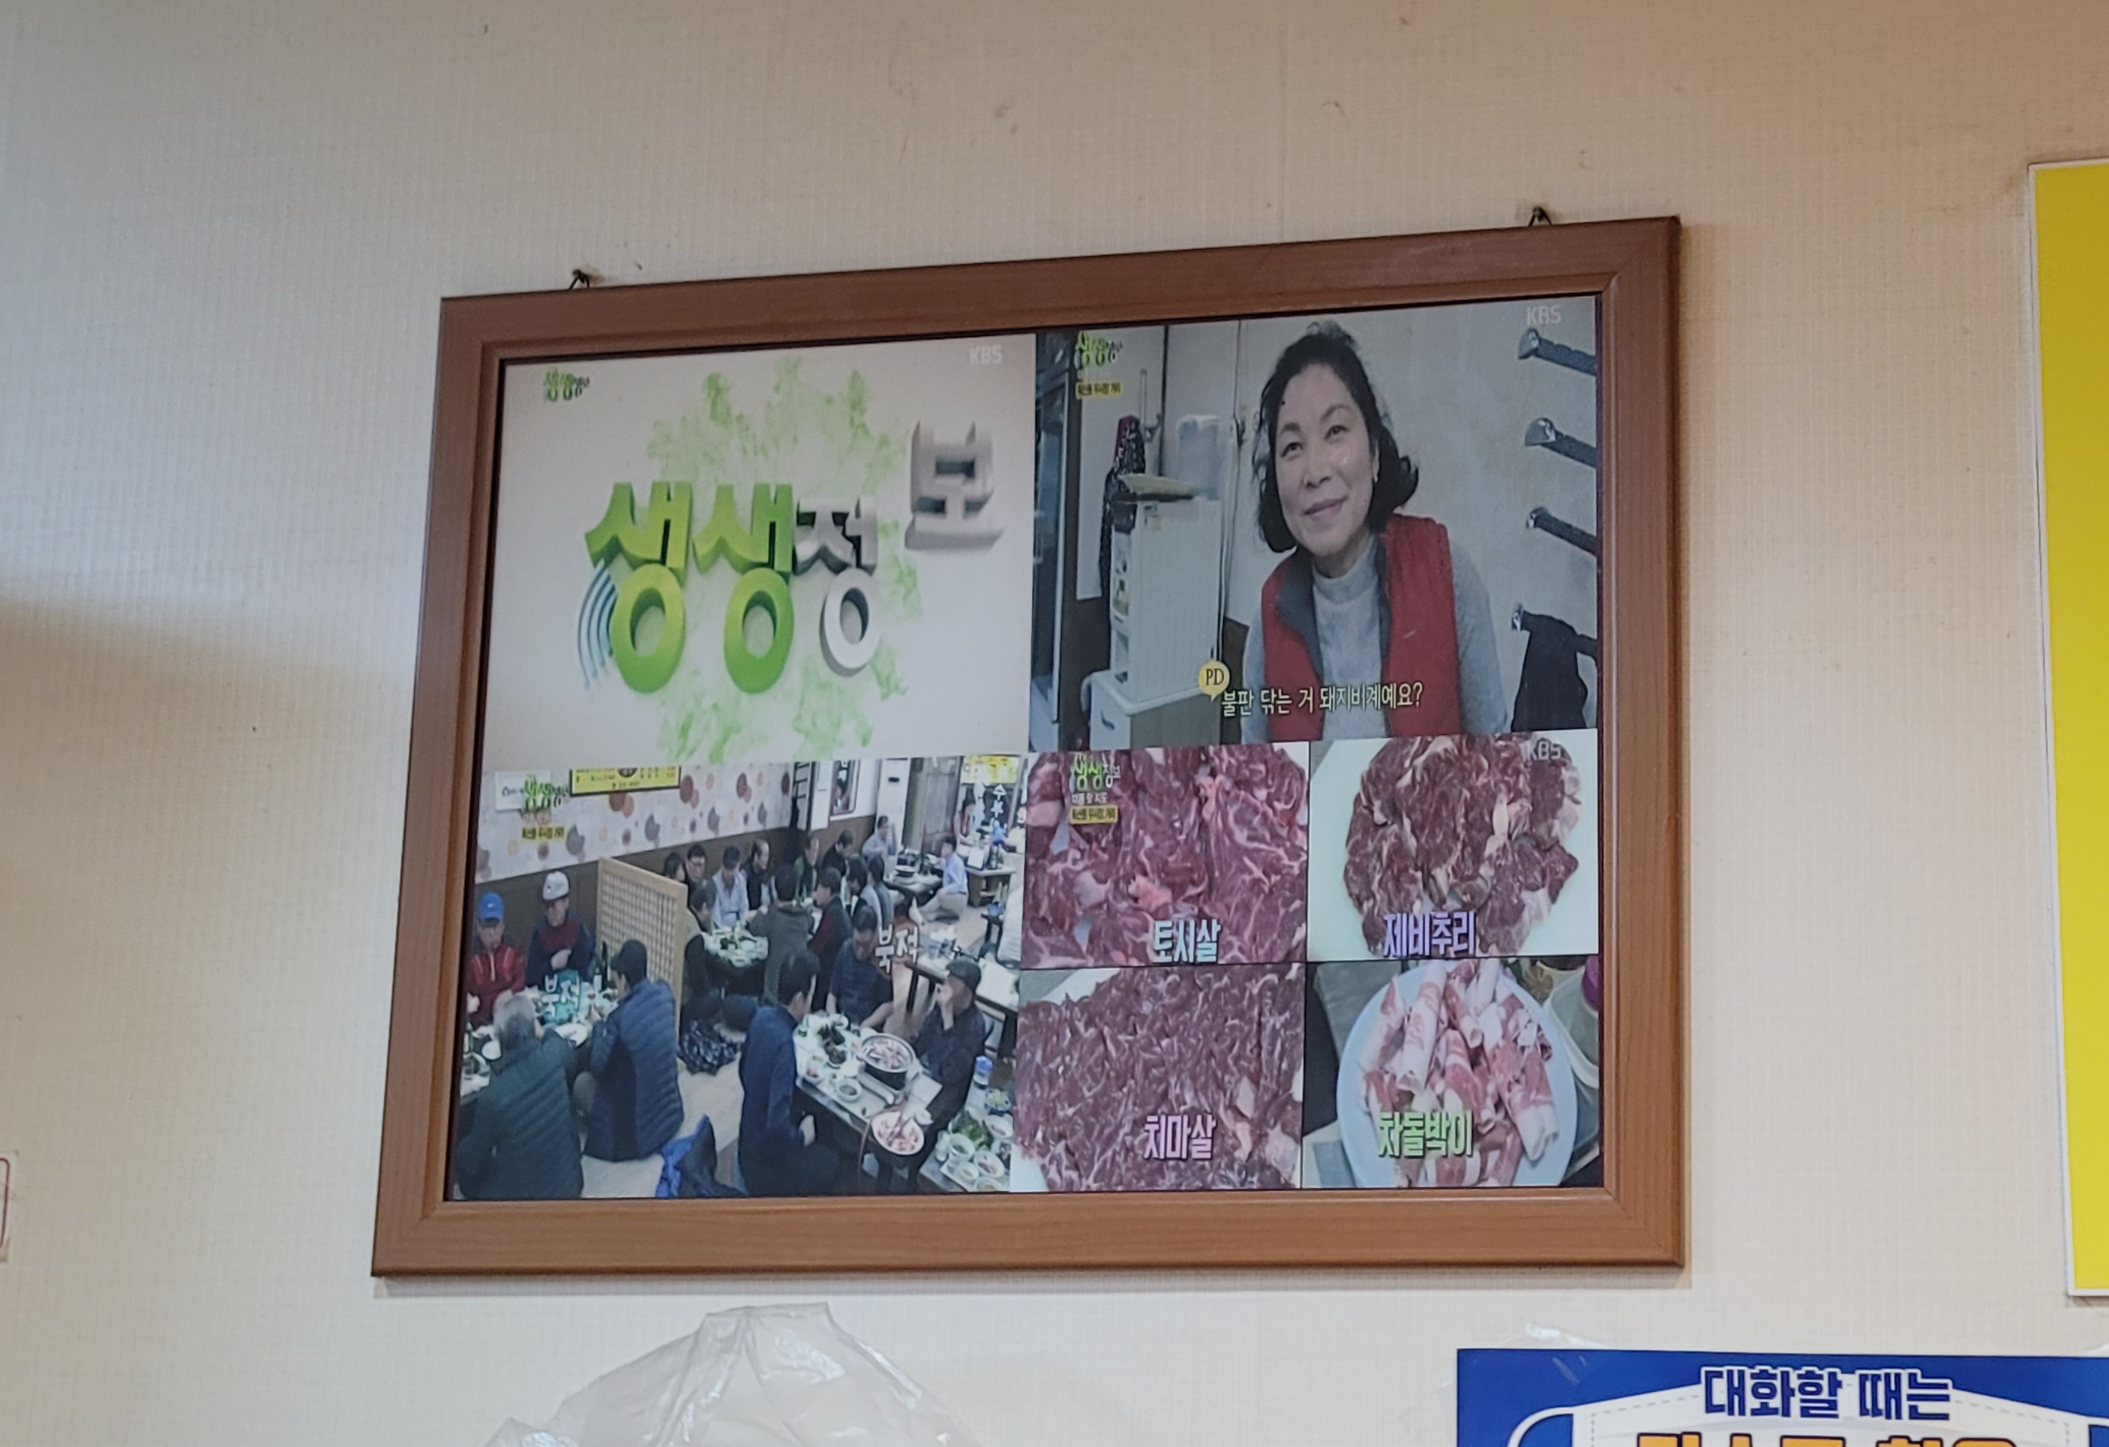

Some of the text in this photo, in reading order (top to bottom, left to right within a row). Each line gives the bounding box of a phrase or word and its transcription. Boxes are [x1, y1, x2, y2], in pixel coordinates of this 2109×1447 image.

[1526, 305, 1562, 327] KBS
[968, 345, 1004, 365] KBS
[584, 420, 1005, 694] 생생정보
[1205, 668, 1225, 686] PD
[1221, 682, 1424, 717] 불판 닦는 거 돼지비계예요?
[1527, 740, 1562, 761] KBS
[875, 923, 918, 973] 북적
[1153, 918, 1221, 964] 토시살
[1382, 911, 1477, 957] 제비추리
[1143, 1110, 1217, 1160] 치마살
[1378, 1109, 1474, 1158] 차돌박이
[1702, 1366, 1951, 1421] 대화할 때는
